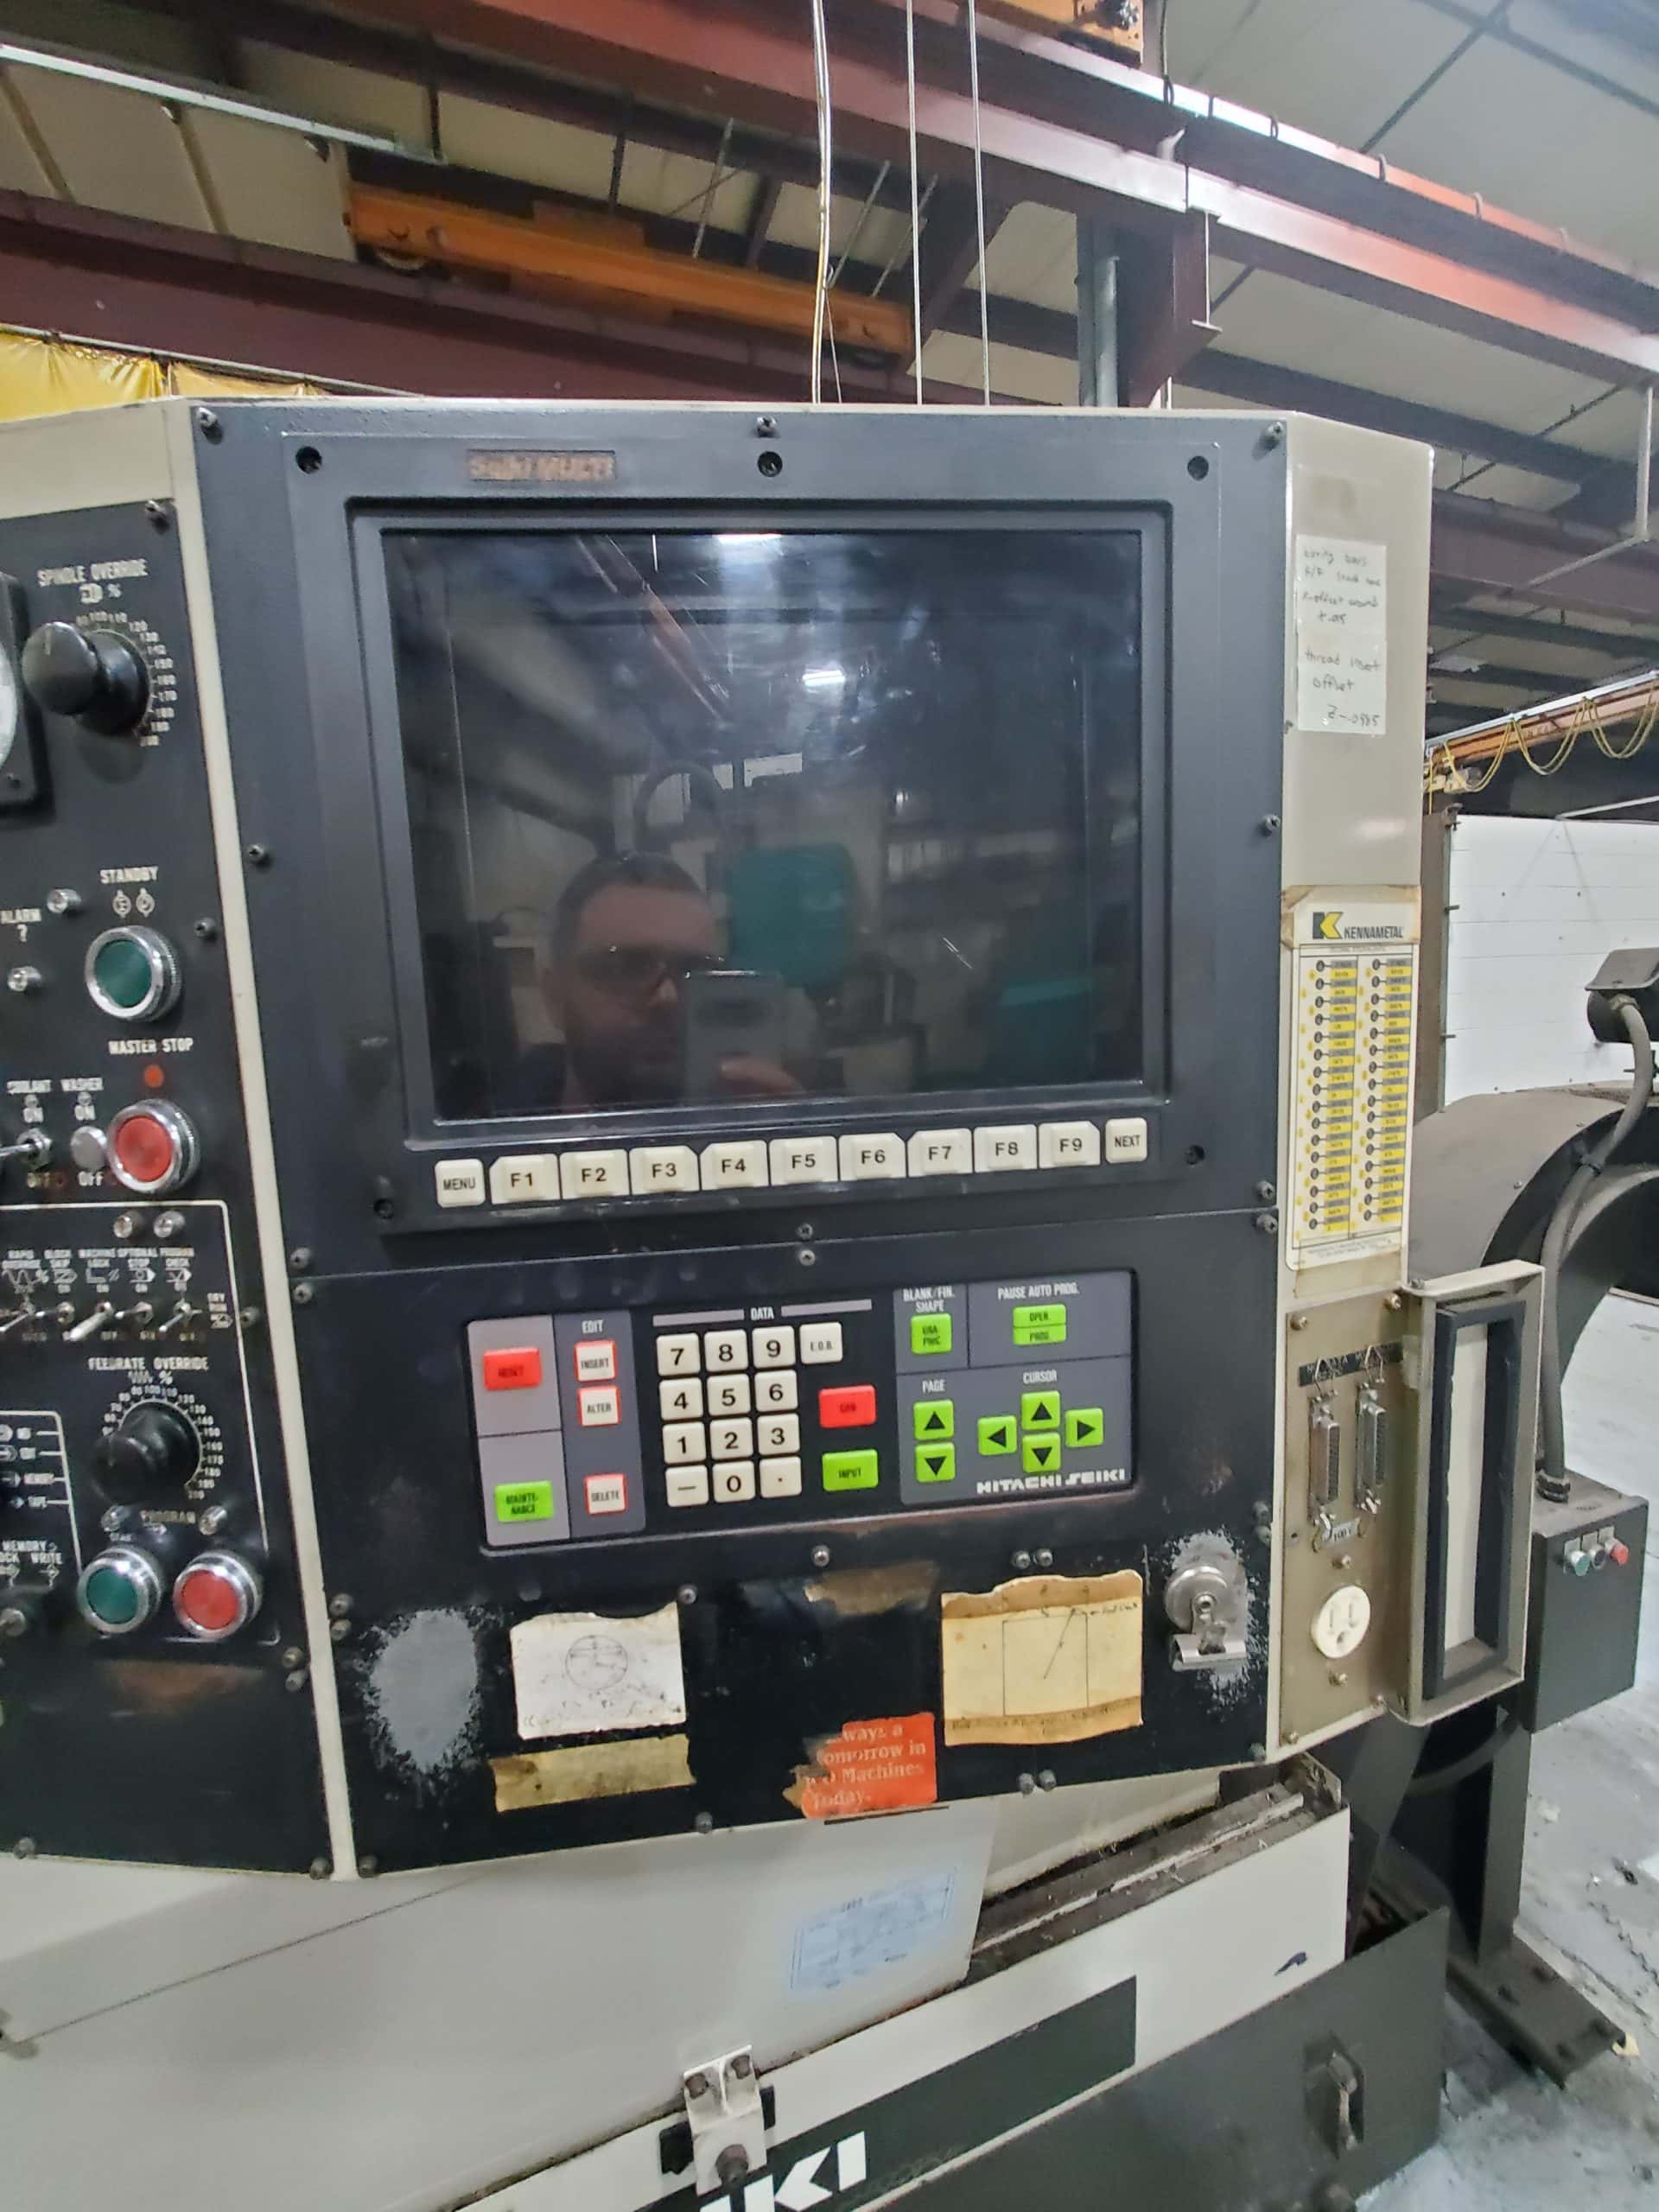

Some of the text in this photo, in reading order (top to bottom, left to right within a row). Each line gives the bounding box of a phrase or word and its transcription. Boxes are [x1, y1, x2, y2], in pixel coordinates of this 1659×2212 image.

[99, 867, 159, 884] STANDBY
[1344, 925, 1404, 939] KENNAMETAL
[108, 1038, 194, 1055] MASTER STOP
[995, 1141, 1019, 1157] F8
[1059, 1137, 1083, 1153] F9
[1114, 1135, 1141, 1147] NEXT
[791, 1154, 816, 1168] F5
[861, 1149, 886, 1165] F6
[928, 1146, 951, 1160] F7
[652, 1163, 677, 1179] F3
[721, 1158, 747, 1173] F4
[511, 1172, 534, 1187] F1
[582, 1167, 607, 1183] F2
[443, 1177, 477, 1192] MENU
[998, 1287, 1027, 1300] PAUSE
[1028, 1284, 1052, 1298] AUTO
[750, 1306, 774, 1321] DATA
[916, 1300, 944, 1313] SHAPE
[582, 1319, 604, 1334] EDIT
[718, 1344, 734, 1363] 8
[766, 1339, 781, 1357] 9
[153, 1356, 209, 1370] OVERRIDE
[581, 1357, 609, 1370] INSERT
[670, 1348, 685, 1366] 7
[1023, 1370, 1058, 1384] CURSOR
[768, 1383, 784, 1402] 6
[922, 1379, 945, 1393] PAGE
[673, 1392, 689, 1410] 4
[721, 1388, 736, 1407] 5
[587, 1402, 612, 1414] ALTER
[724, 1432, 739, 1450] 2
[771, 1427, 785, 1446] 3
[677, 1436, 687, 1454] 1
[838, 1467, 862, 1479] INPUT
[976, 1468, 1125, 1494] HITACHI SEIKI
[727, 1475, 741, 1493] 0
[591, 1489, 620, 1502] DELETE
[893, 1724, 903, 1737] a
[909, 1739, 926, 1756] in
[842, 1762, 925, 1783] Machines
